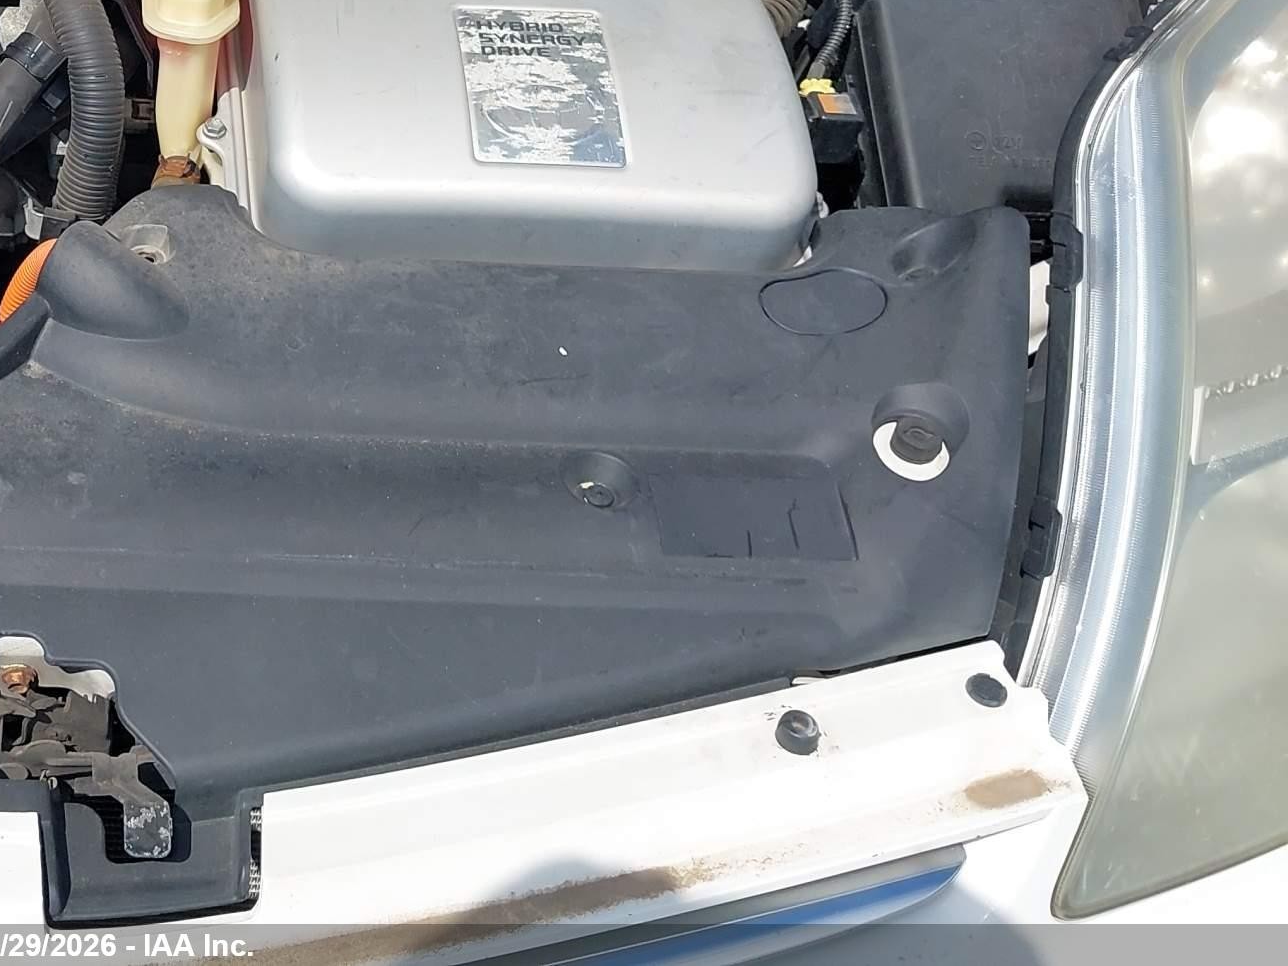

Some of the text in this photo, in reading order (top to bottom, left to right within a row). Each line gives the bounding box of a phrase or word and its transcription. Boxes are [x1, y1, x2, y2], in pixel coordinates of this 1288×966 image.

[476, 20, 563, 33] HYBRID
[479, 32, 586, 46] SYNERGY
[481, 45, 552, 57] DRIVE
